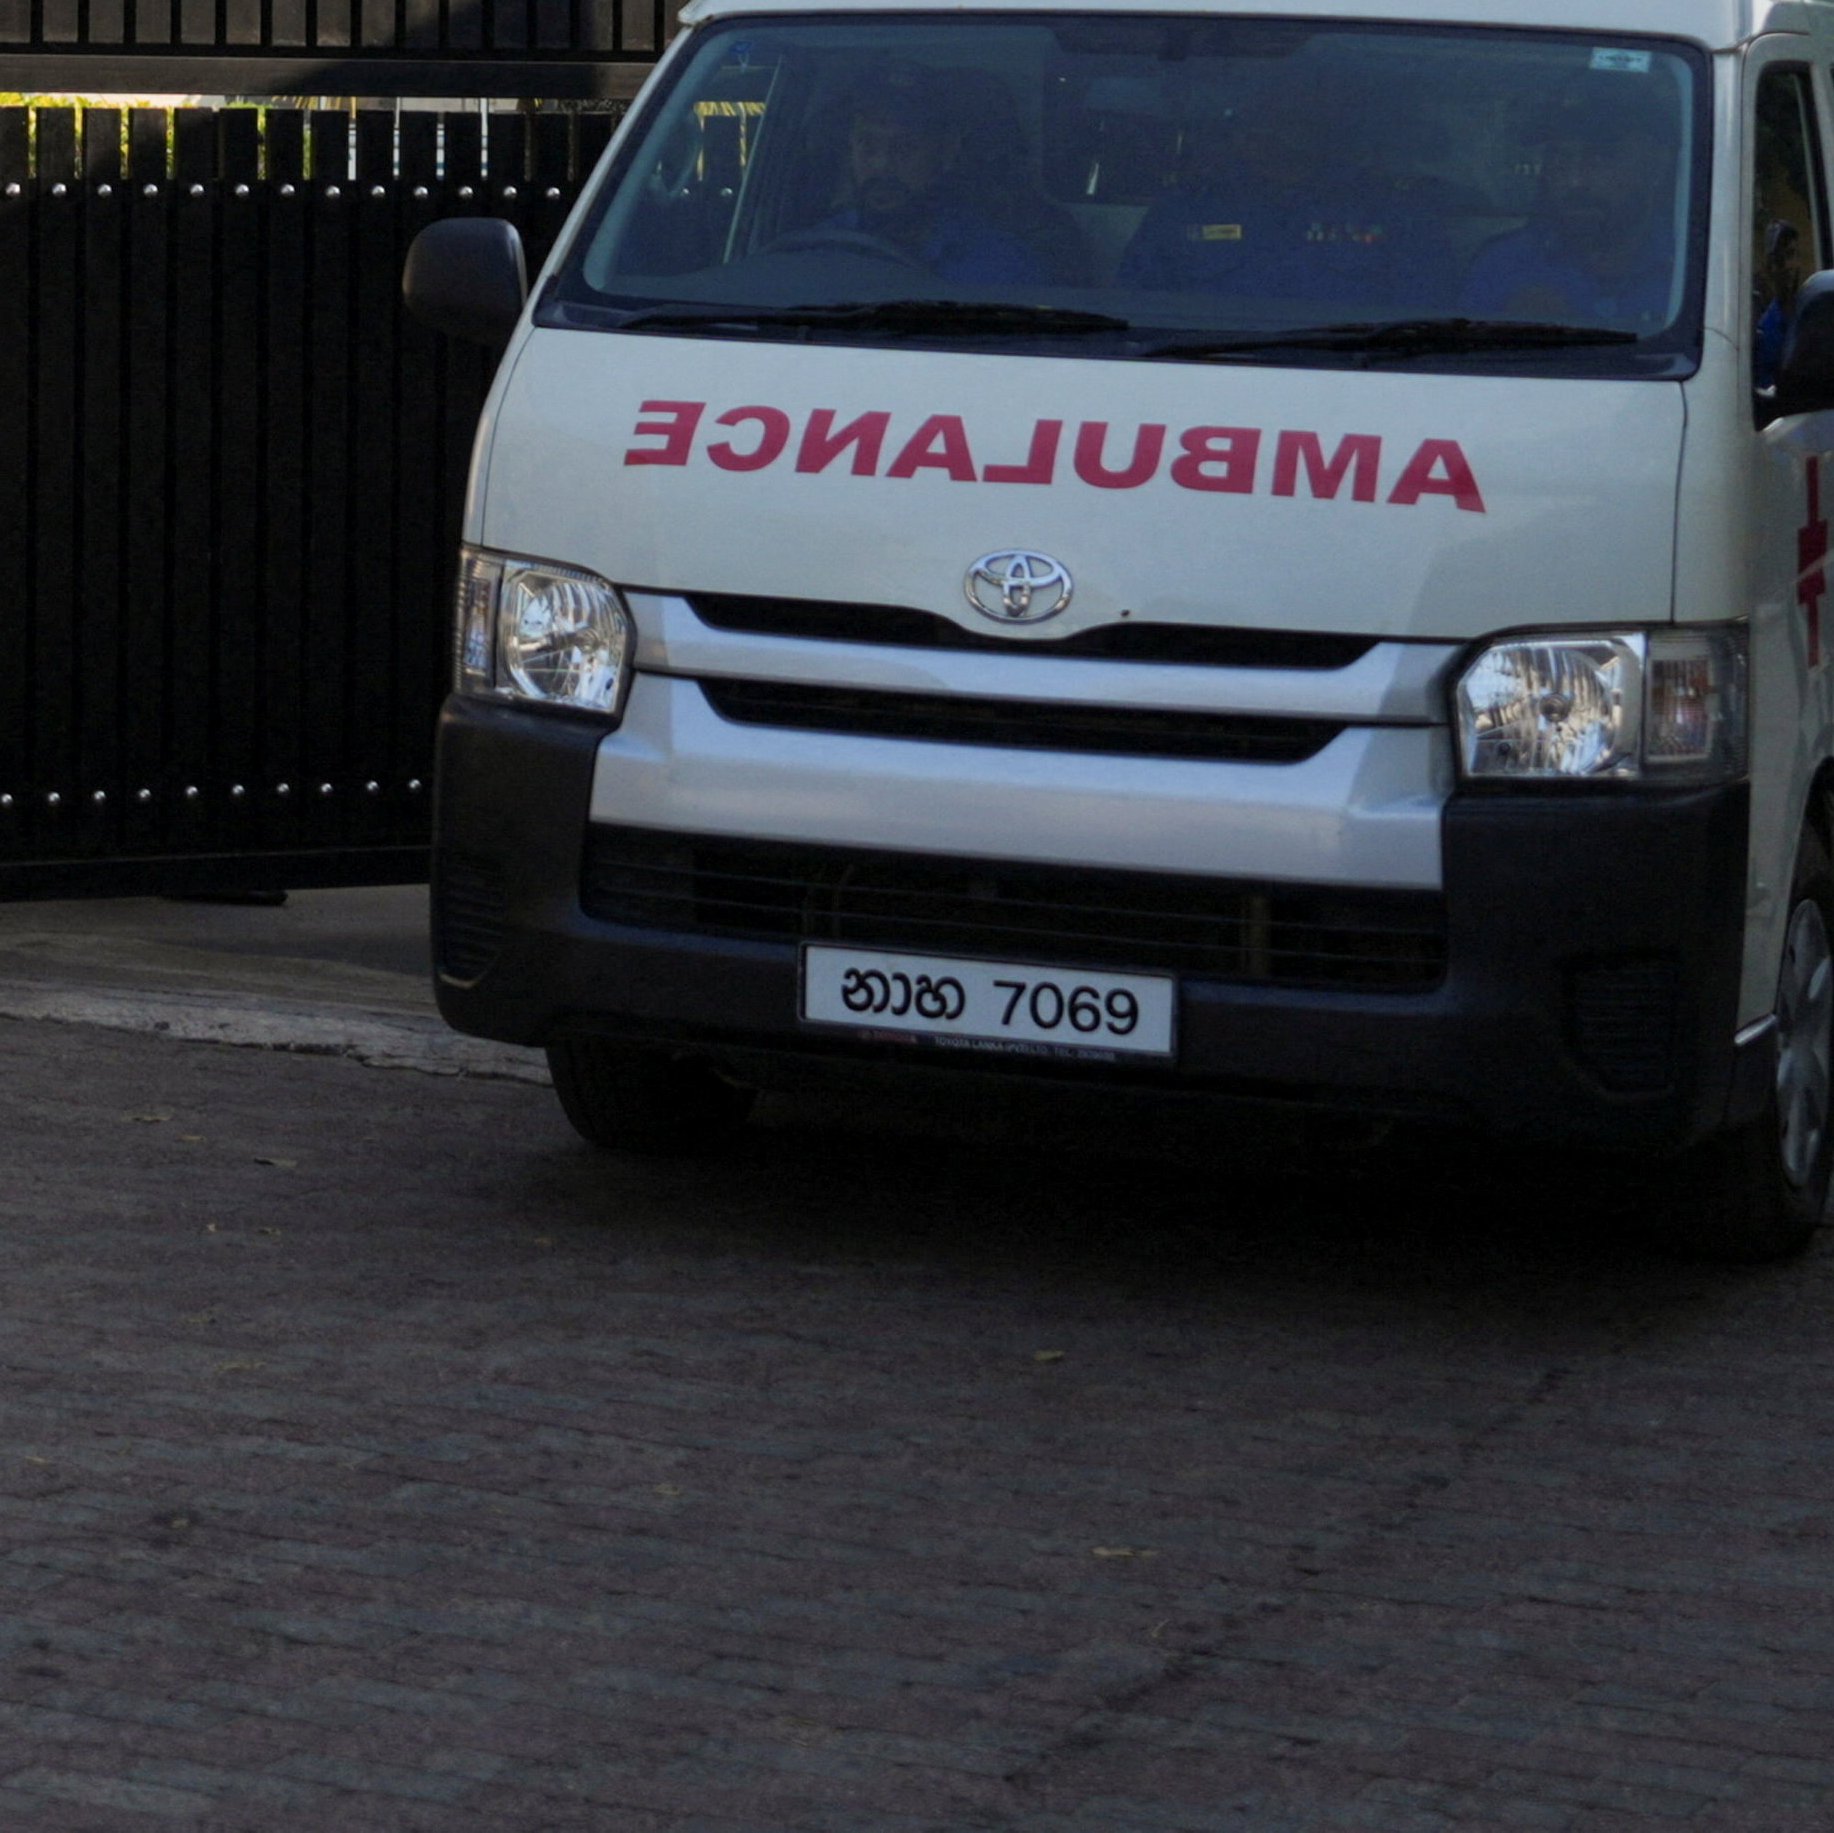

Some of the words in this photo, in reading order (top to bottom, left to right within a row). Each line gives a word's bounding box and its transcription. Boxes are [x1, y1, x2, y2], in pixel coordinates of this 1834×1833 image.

[841, 967, 966, 1020] නාහ
[993, 979, 1139, 1036] 7069
[935, 1036, 969, 1048] TOYOTA
